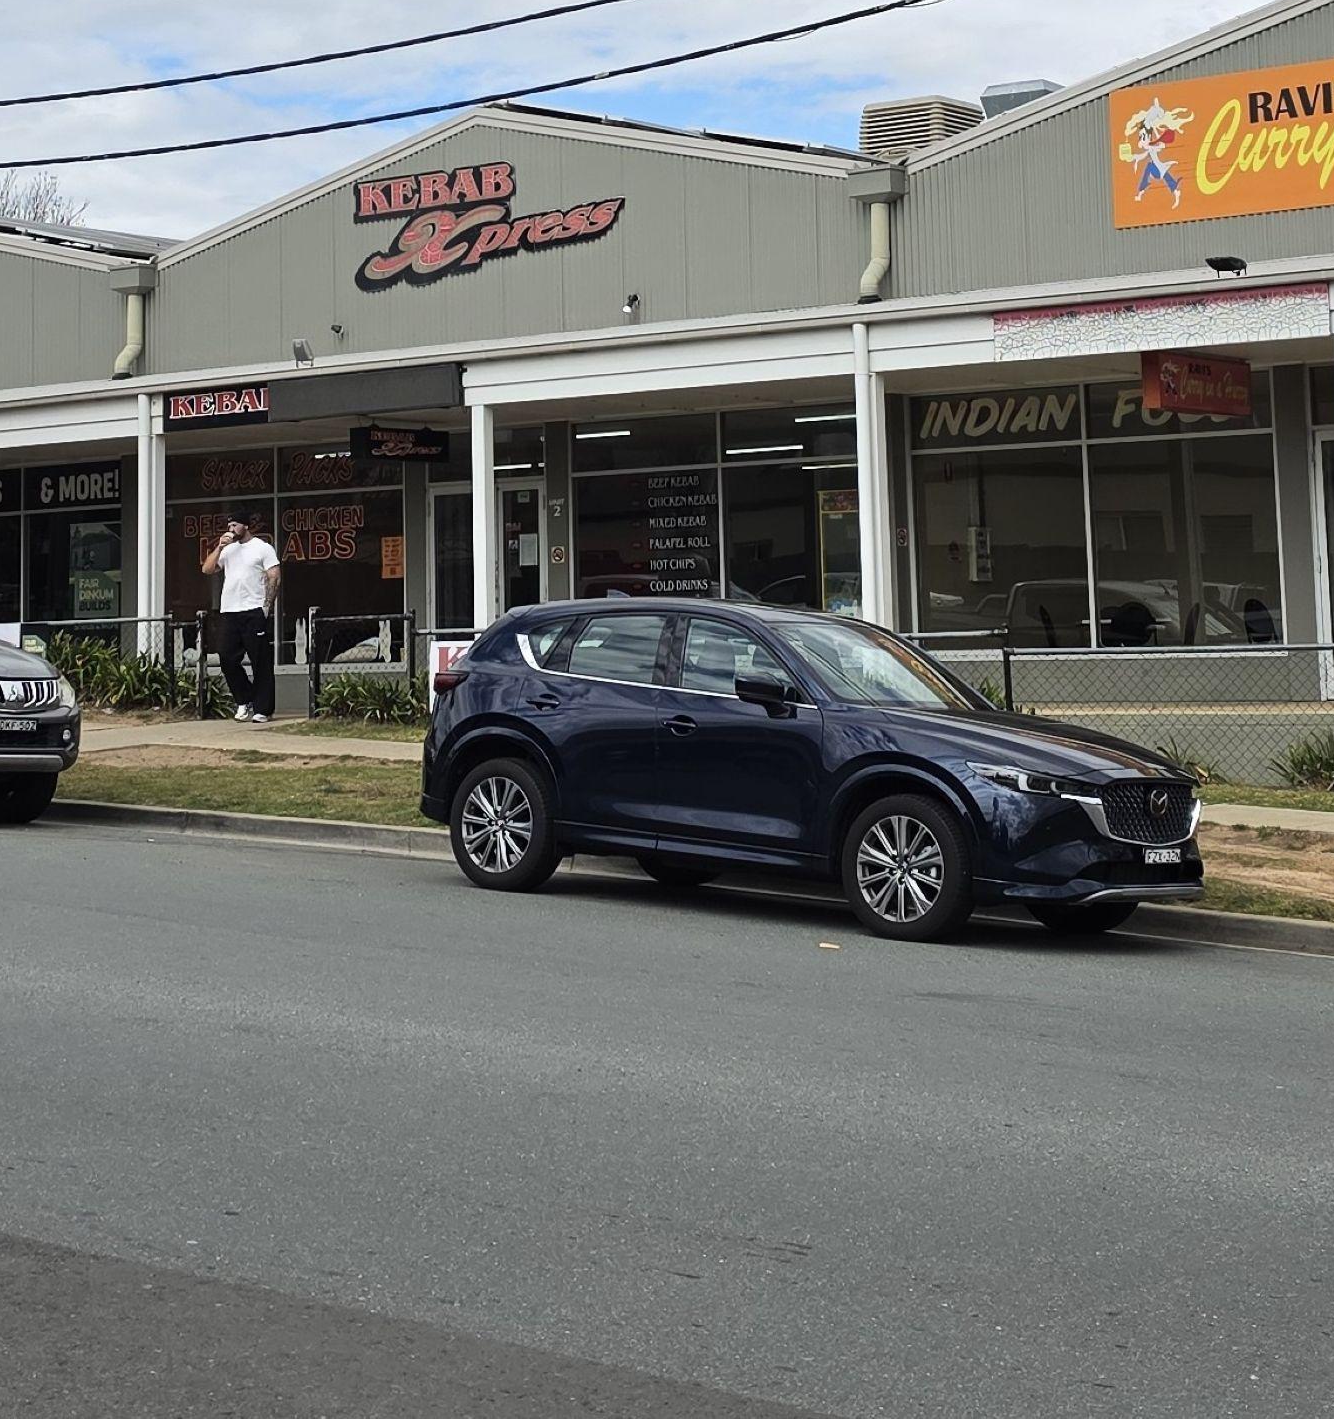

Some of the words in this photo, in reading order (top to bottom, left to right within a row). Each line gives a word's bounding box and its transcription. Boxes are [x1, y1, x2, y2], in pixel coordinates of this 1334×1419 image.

[357, 163, 514, 216] KEBAB
[364, 197, 624, 280] Xpress
[920, 393, 1076, 439] INDIAN
[202, 457, 270, 492] SNACK
[286, 451, 356, 487] PACKS
[40, 477, 55, 504] &
[58, 469, 120, 503] MORE!
[670, 476, 699, 487] KEBAB
[648, 496, 687, 508] CHICKEN
[687, 494, 717, 505] KEBAB
[553, 505, 561, 516] 2
[184, 514, 230, 538] BEE
[282, 505, 365, 531] CHICKEN
[649, 518, 676, 528] MIXED
[678, 516, 706, 526] KEBAB
[199, 529, 358, 566] KABS
[688, 536, 711, 547] ROLL
[650, 559, 668, 570] HOT
[669, 558, 696, 570] CHIPS
[79, 578, 100, 589] FAIR
[649, 580, 674, 592] COLD
[676, 579, 708, 591] DRINKS
[78, 589, 114, 600] DINKUM
[78, 600, 111, 611] BUILDS
